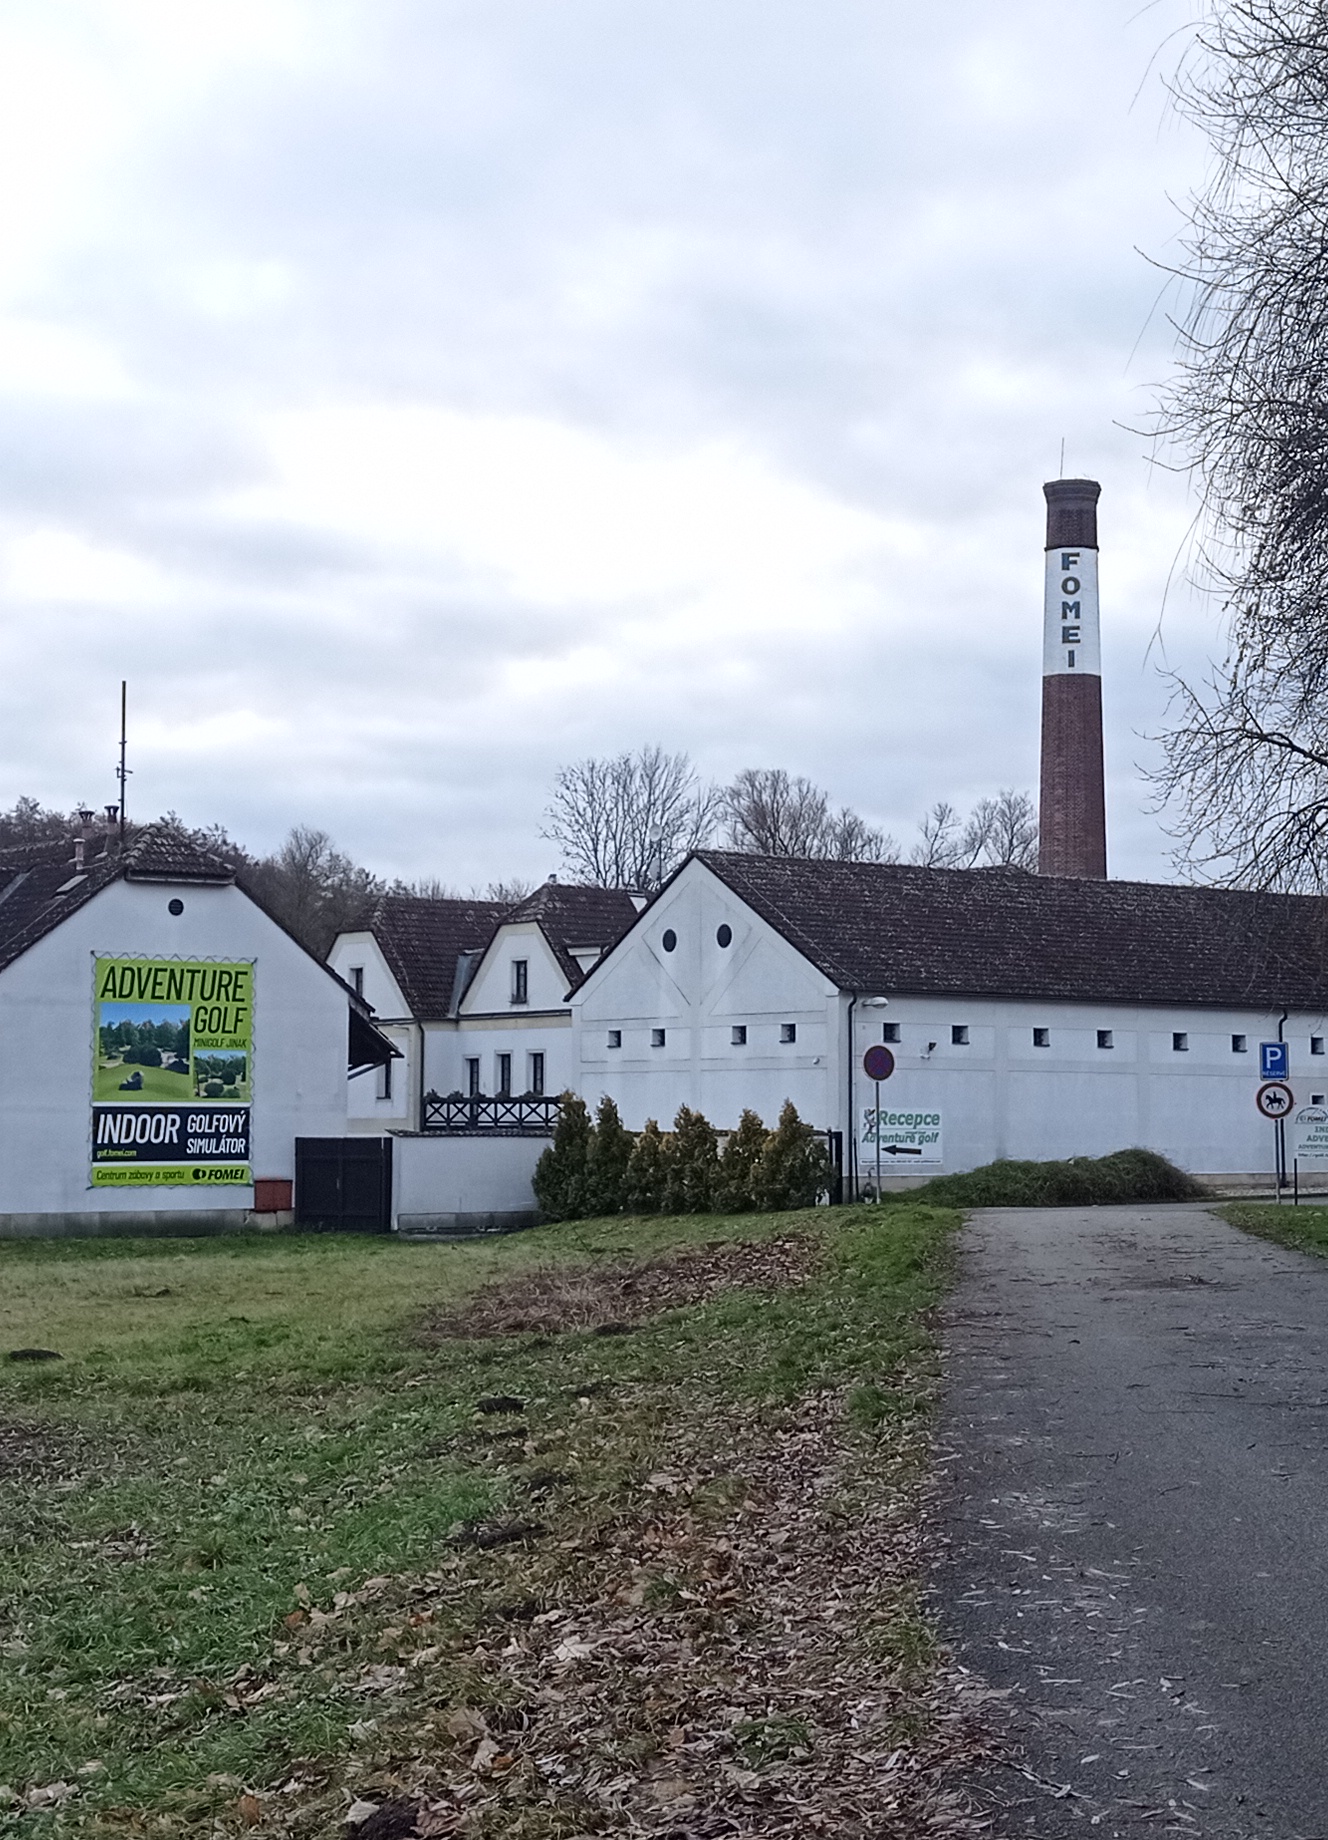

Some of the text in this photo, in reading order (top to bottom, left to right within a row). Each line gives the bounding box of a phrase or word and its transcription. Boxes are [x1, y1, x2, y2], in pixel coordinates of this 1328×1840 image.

[1061, 552, 1081, 668] FOMEI
[100, 966, 248, 1002] ADVENTURE
[194, 1006, 247, 1034] GOLF
[194, 1038, 247, 1048] MINIGOLF JINAK
[1266, 1047, 1282, 1069] P
[97, 1113, 180, 1144] INDOOR
[187, 1111, 246, 1133] GOLFOVÝ
[879, 1110, 940, 1129] Recepce
[186, 1135, 245, 1154] SIMULÁTOR
[918, 1131, 939, 1145] golf
[97, 1170, 126, 1180] Centrum
[128, 1170, 154, 1181] zábavy
[162, 1171, 185, 1181] sportu
[208, 1169, 244, 1180] FOMEI
